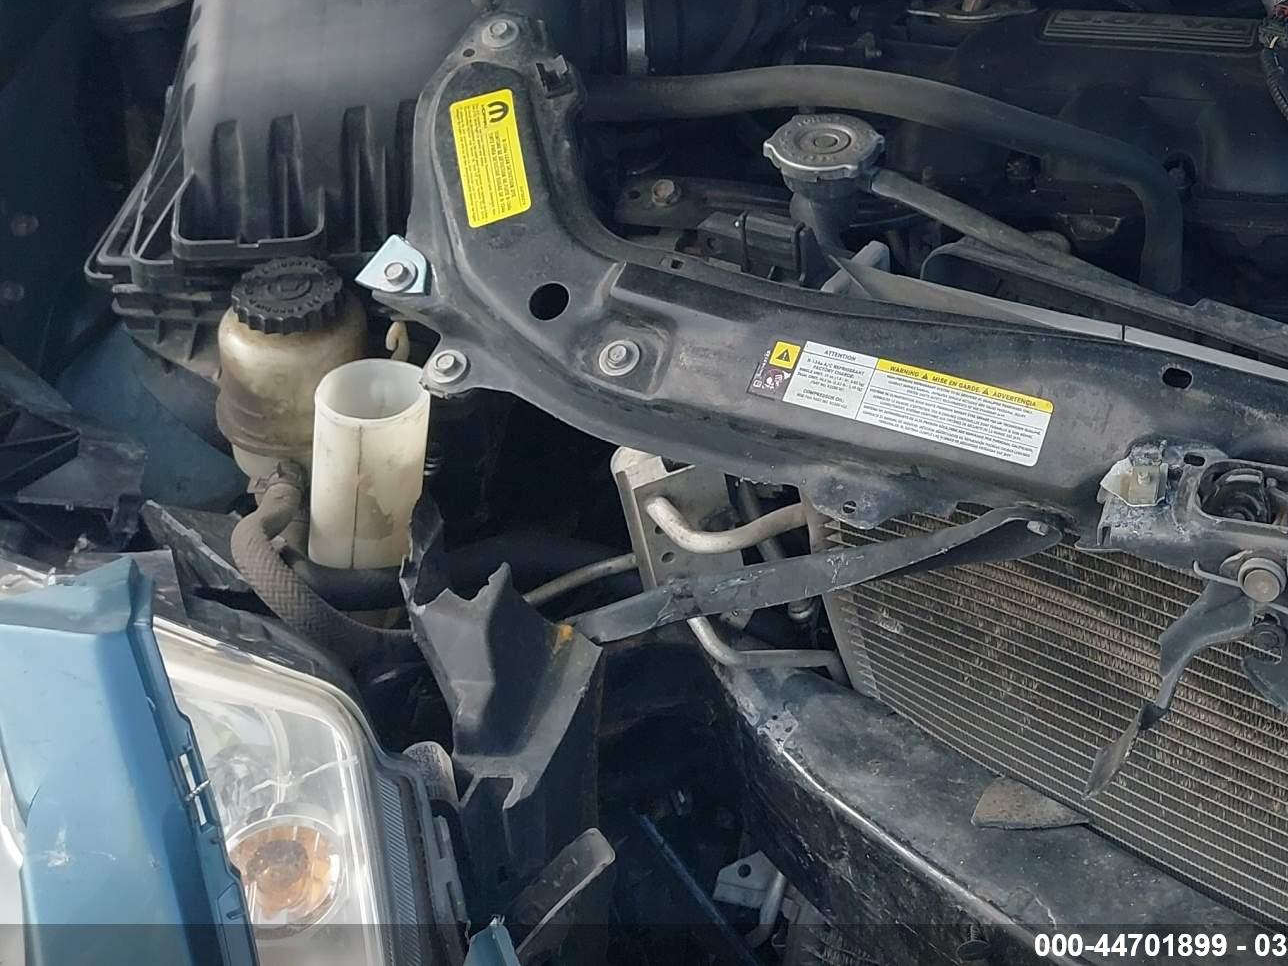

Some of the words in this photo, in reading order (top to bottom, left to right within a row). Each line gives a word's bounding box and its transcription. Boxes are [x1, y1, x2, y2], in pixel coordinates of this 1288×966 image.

[823, 349, 856, 361] ATTENTION
[889, 363, 919, 378] WARNING
[931, 375, 946, 384] MISE
[946, 379, 958, 387] EN
[957, 381, 980, 393] GARDE
